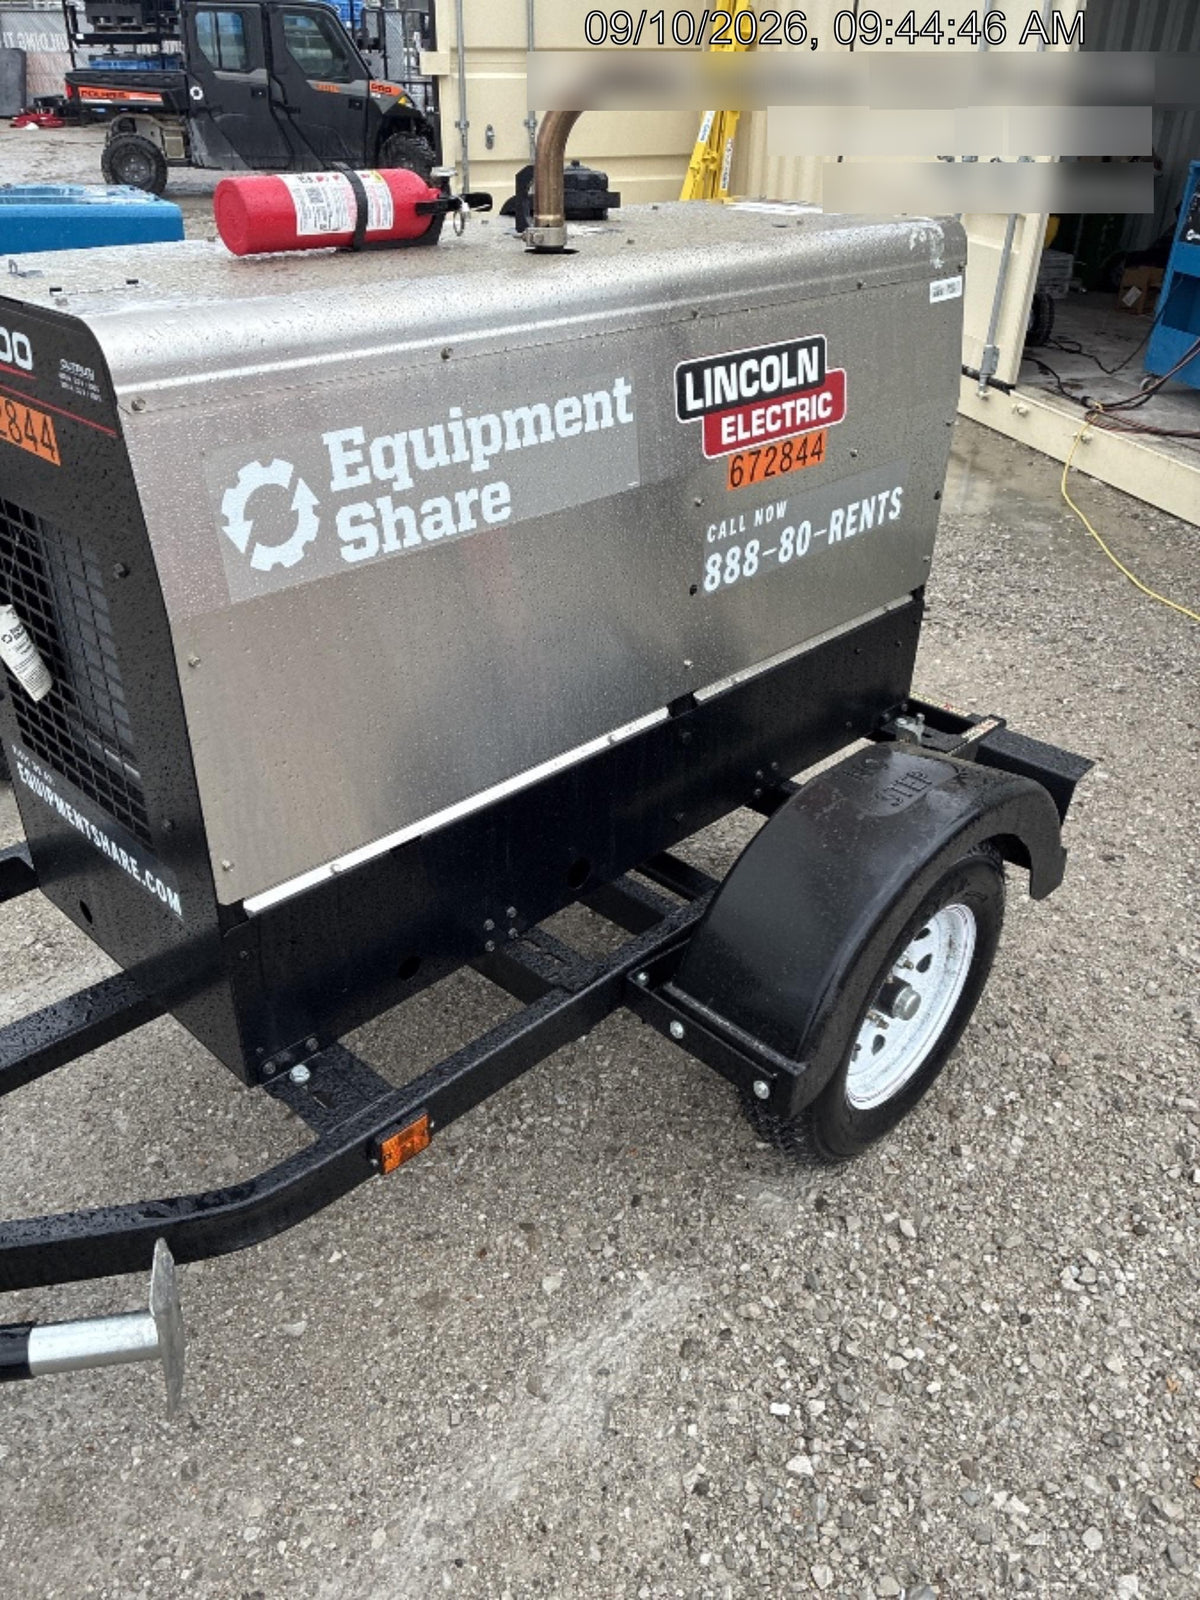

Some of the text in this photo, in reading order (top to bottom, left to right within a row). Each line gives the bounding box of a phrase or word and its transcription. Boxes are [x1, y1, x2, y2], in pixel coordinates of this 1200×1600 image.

[685, 346, 820, 412] LINCOLN
[321, 377, 634, 493] Equipment
[721, 392, 833, 446] ELECTRIC
[730, 432, 824, 488] 672844
[336, 480, 511, 563] Share
[703, 486, 905, 592] 888-80-RENTS
[707, 500, 788, 543] CALL NOW
[16, 761, 183, 917] EQUIPMENTSHARE.COM
